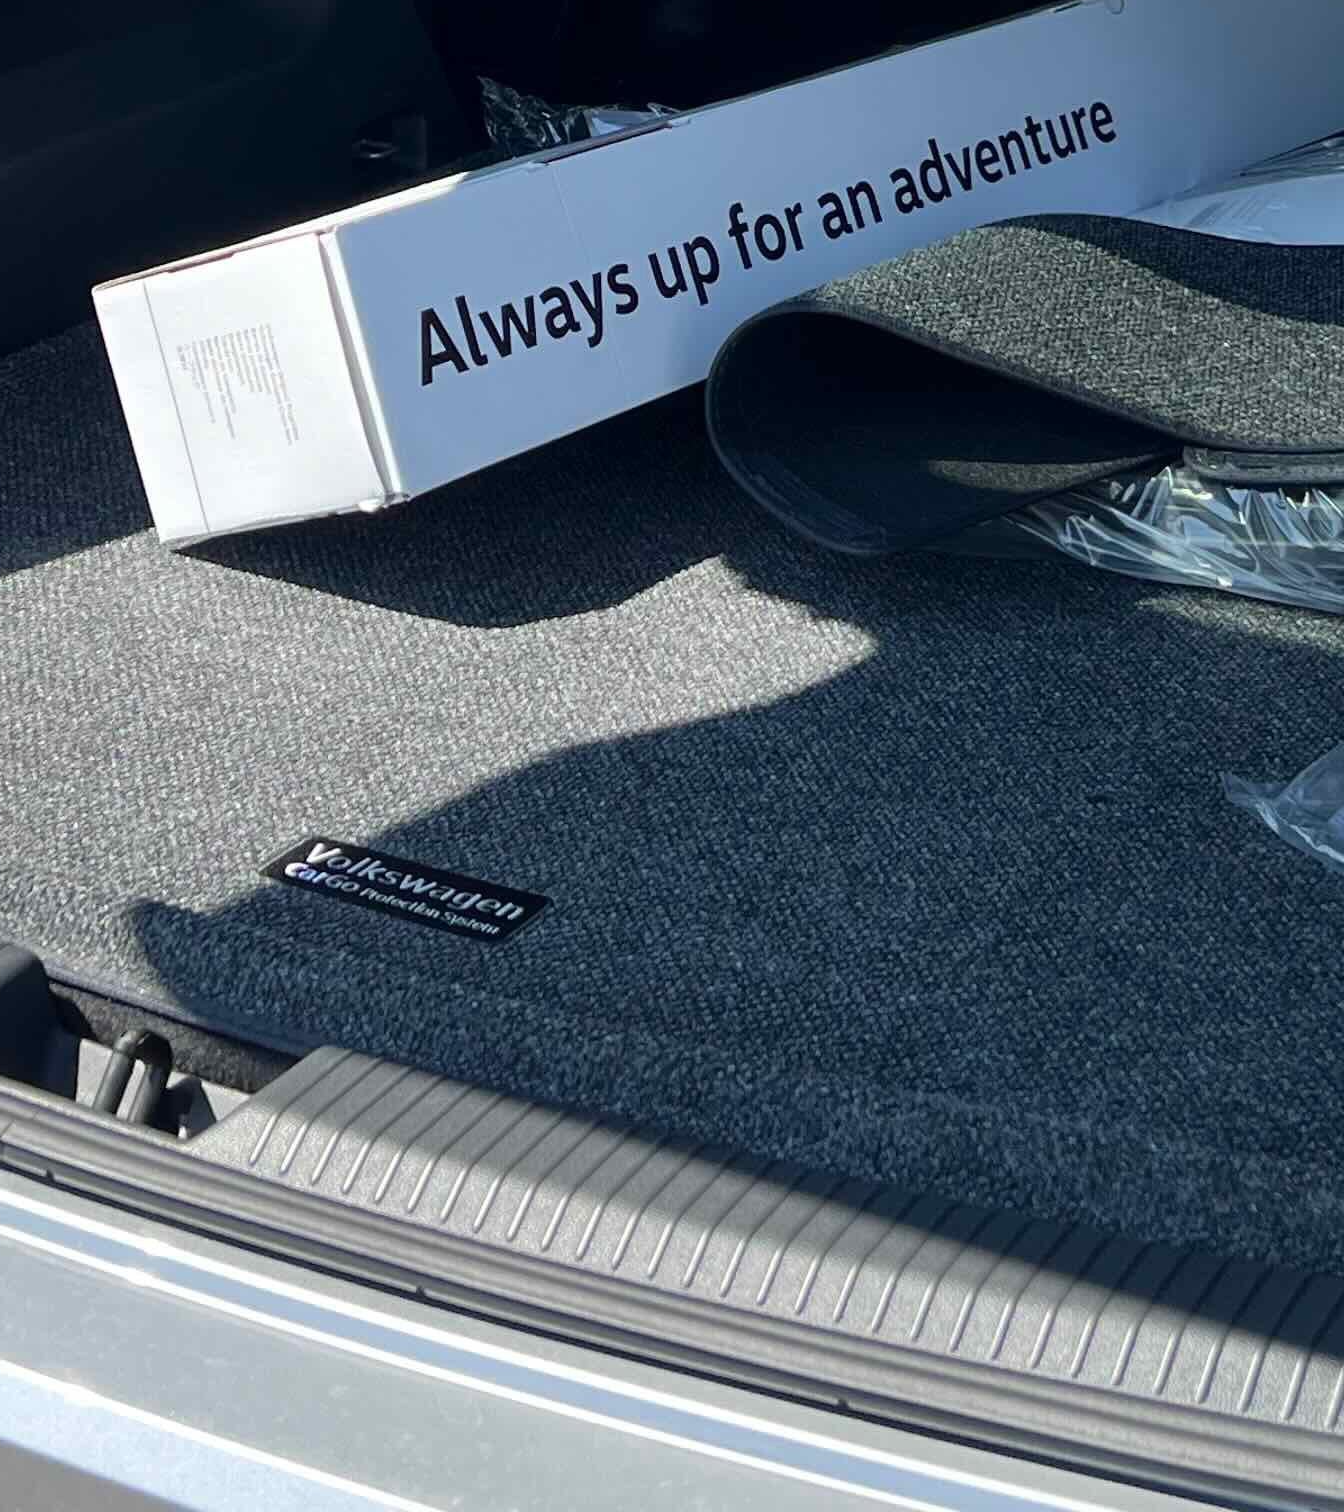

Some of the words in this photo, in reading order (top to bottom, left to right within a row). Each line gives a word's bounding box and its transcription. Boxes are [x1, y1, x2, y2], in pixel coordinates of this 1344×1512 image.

[422, 264, 638, 385] Always
[649, 237, 719, 304] up
[728, 203, 803, 269] for
[818, 182, 882, 238] an
[891, 103, 1116, 213] adventure
[306, 843, 523, 920] Volkswagen
[359, 888, 440, 919] Protection
